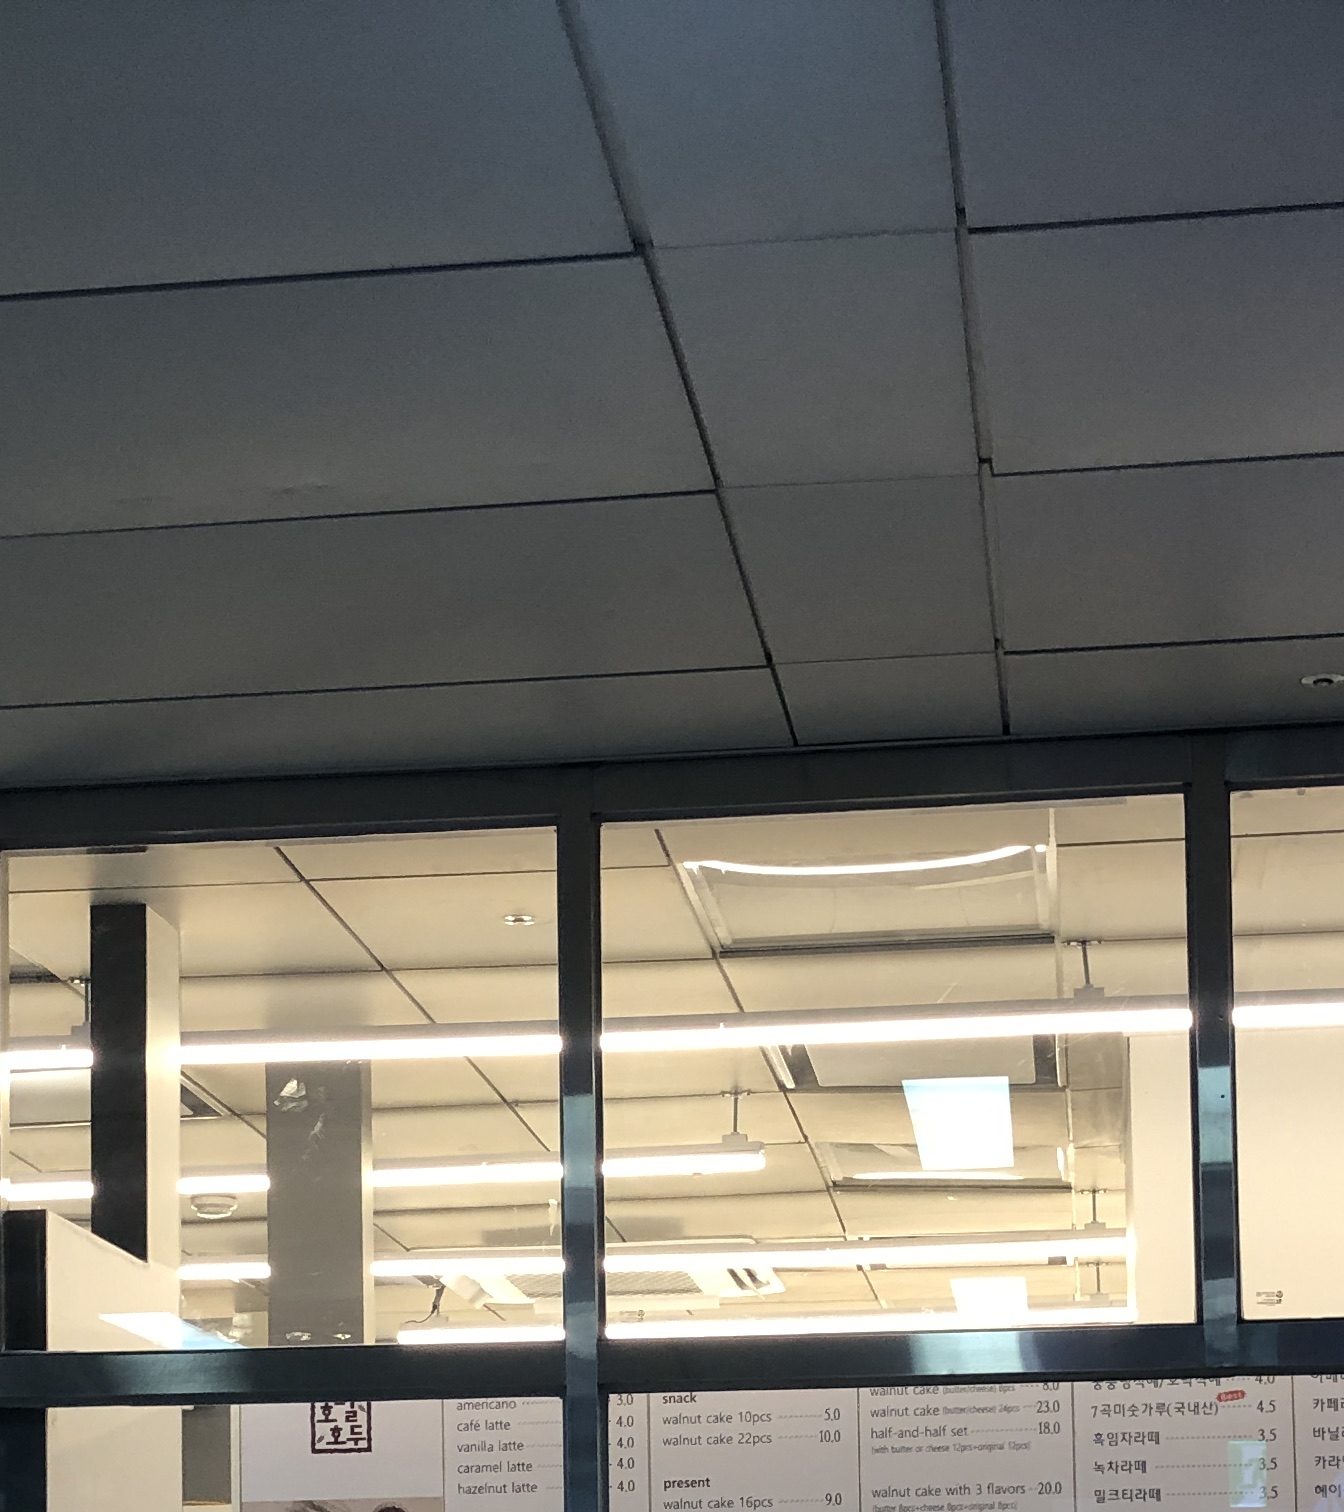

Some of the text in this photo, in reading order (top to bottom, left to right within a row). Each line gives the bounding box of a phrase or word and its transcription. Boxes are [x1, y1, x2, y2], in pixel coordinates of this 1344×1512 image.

[456, 1394, 633, 1410] americano 3.0
[662, 1393, 697, 1404] snack
[1257, 1401, 1276, 1413] 4.5
[457, 1416, 634, 1431] café latte 4.0
[662, 1409, 840, 1426] walnut cake 10pcs 5.0
[326, 1425, 366, 1446] 호두
[870, 1422, 1060, 1439] half-and-half set 18.0
[1258, 1429, 1277, 1442] 3.5
[458, 1480, 635, 1495] hazelnut latte 4.0
[663, 1478, 710, 1491] present
[871, 1482, 1061, 1498] walnut cake with 3 flavors 20.0
[663, 1494, 842, 1511] walnut cake 16pcs 9.0
